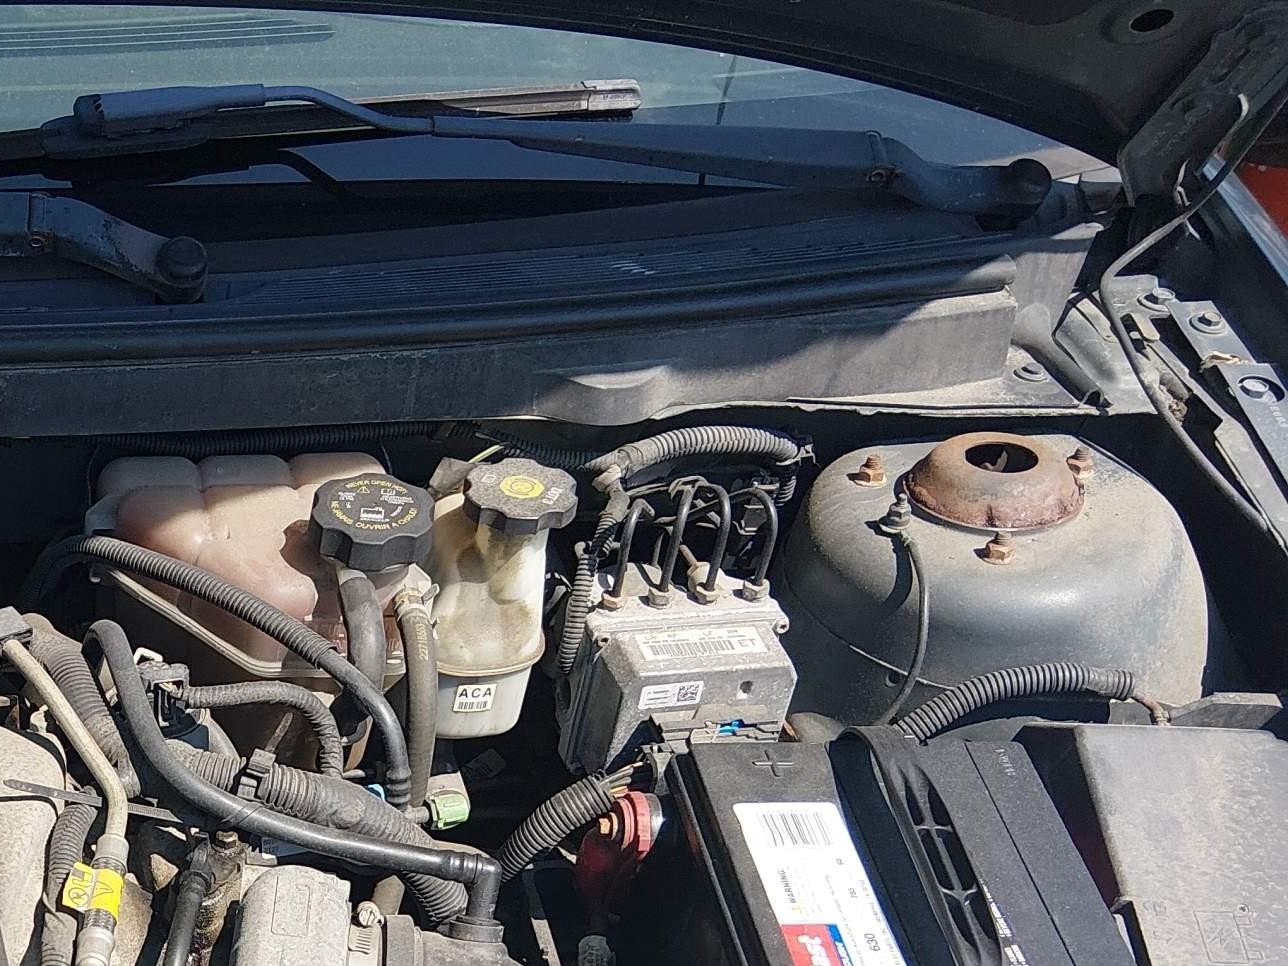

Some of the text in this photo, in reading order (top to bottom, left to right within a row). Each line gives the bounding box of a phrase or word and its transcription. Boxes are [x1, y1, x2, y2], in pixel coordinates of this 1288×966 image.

[371, 480, 392, 488] OPEN
[738, 638, 757, 647] ET
[458, 687, 492, 698] ACA
[863, 932, 881, 952] 630
